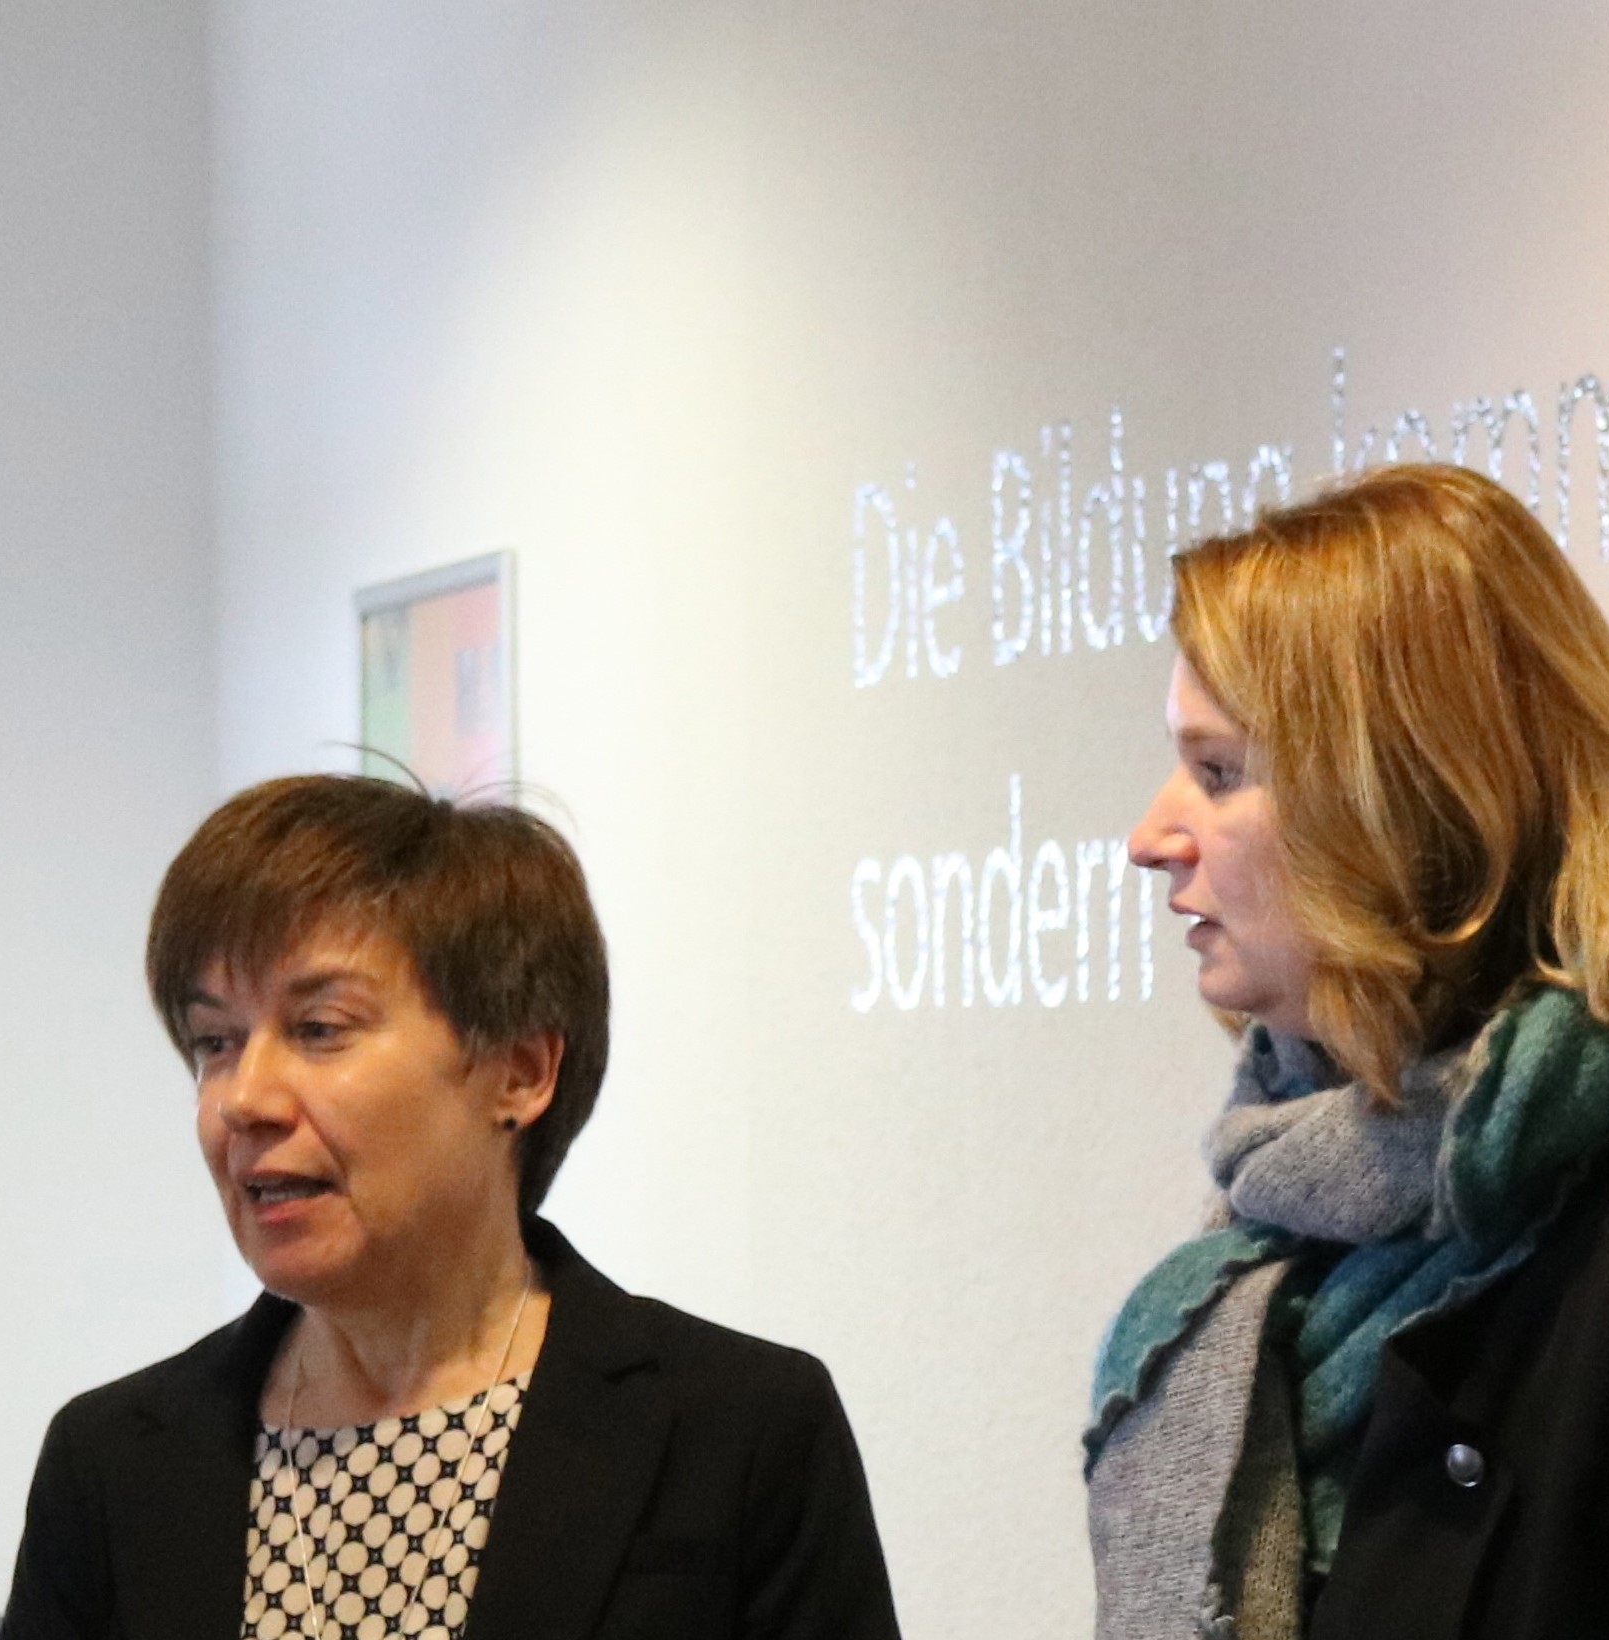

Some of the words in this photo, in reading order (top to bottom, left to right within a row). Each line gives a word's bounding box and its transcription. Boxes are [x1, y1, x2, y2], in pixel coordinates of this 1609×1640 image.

[853, 460, 965, 689] Die
[992, 405, 1291, 667] Bildu
[850, 773, 1154, 1013] sondern
